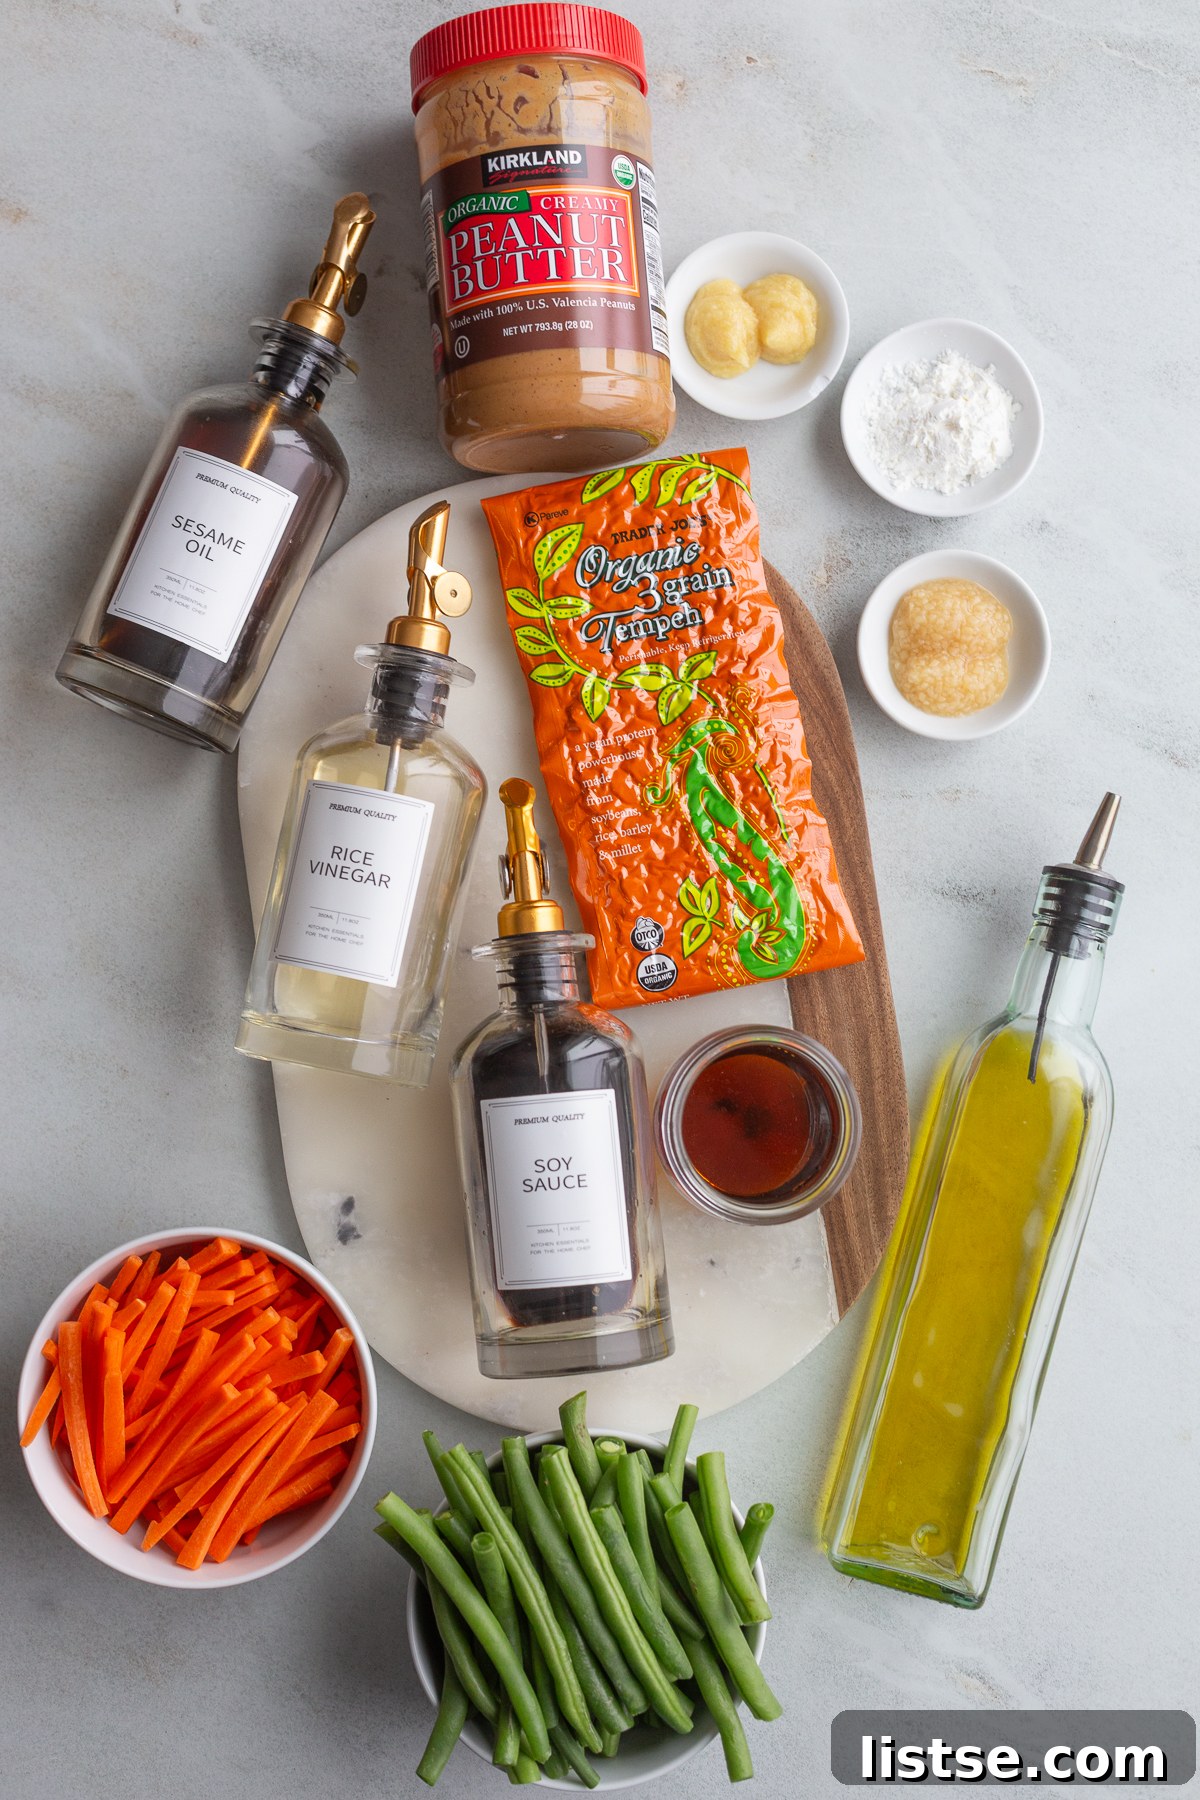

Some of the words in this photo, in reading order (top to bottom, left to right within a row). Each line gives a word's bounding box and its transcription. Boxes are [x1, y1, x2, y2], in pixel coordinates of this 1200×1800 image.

[487, 150, 582, 172] KIRKLAND
[617, 163, 631, 172] USDA
[488, 165, 583, 185] Signature
[448, 195, 519, 224] ORGANIC
[540, 196, 619, 212] CREAMY
[448, 212, 626, 267] PEANUT
[451, 246, 628, 301] BUTTER
[450, 316, 471, 331] Made
[473, 309, 494, 322] with
[496, 303, 523, 316] 100%
[526, 299, 549, 310] U.S.
[552, 297, 598, 308] Valencia
[600, 298, 636, 311] Peanuts
[503, 326, 518, 337] NET
[520, 324, 533, 334] WT
[535, 322, 563, 332] 793.8g
[565, 321, 578, 330] (28
[579, 321, 593, 330] OZ)
[195, 472, 229, 490] PREMIUM
[229, 486, 262, 504] QUALITY
[540, 509, 569, 521] Pareve
[171, 514, 246, 555] SESAME
[611, 522, 667, 545] TRADER
[185, 539, 214, 562] OIL
[575, 536, 701, 593] Organic
[150, 589, 161, 597] FOR
[633, 571, 664, 614] 3
[662, 563, 735, 606] grain
[580, 601, 703, 654] Tempeh
[668, 642, 690, 653] Keep
[692, 628, 745, 648] Refrigerated
[575, 744, 581, 752] a
[583, 738, 614, 751] vegan
[615, 726, 658, 746] protein
[578, 749, 644, 773] powerhouse
[582, 773, 612, 787] made
[586, 794, 614, 806] from
[328, 802, 362, 815] PREMIUM
[363, 809, 398, 822] QUALITY
[591, 808, 642, 825] soybeans,
[620, 823, 652, 837] barley
[330, 845, 375, 866] RICE
[599, 850, 609, 860] &
[611, 843, 642, 858] millet
[309, 860, 391, 888] VINEGAR
[636, 929, 657, 941] OTCO
[644, 961, 668, 974] USDA
[644, 972, 673, 985] ORGANIC
[514, 1116, 549, 1126] PREMIUM
[551, 1113, 585, 1123] QUALITY
[534, 1156, 573, 1174] SOY
[522, 1174, 588, 1193] SAUCE
